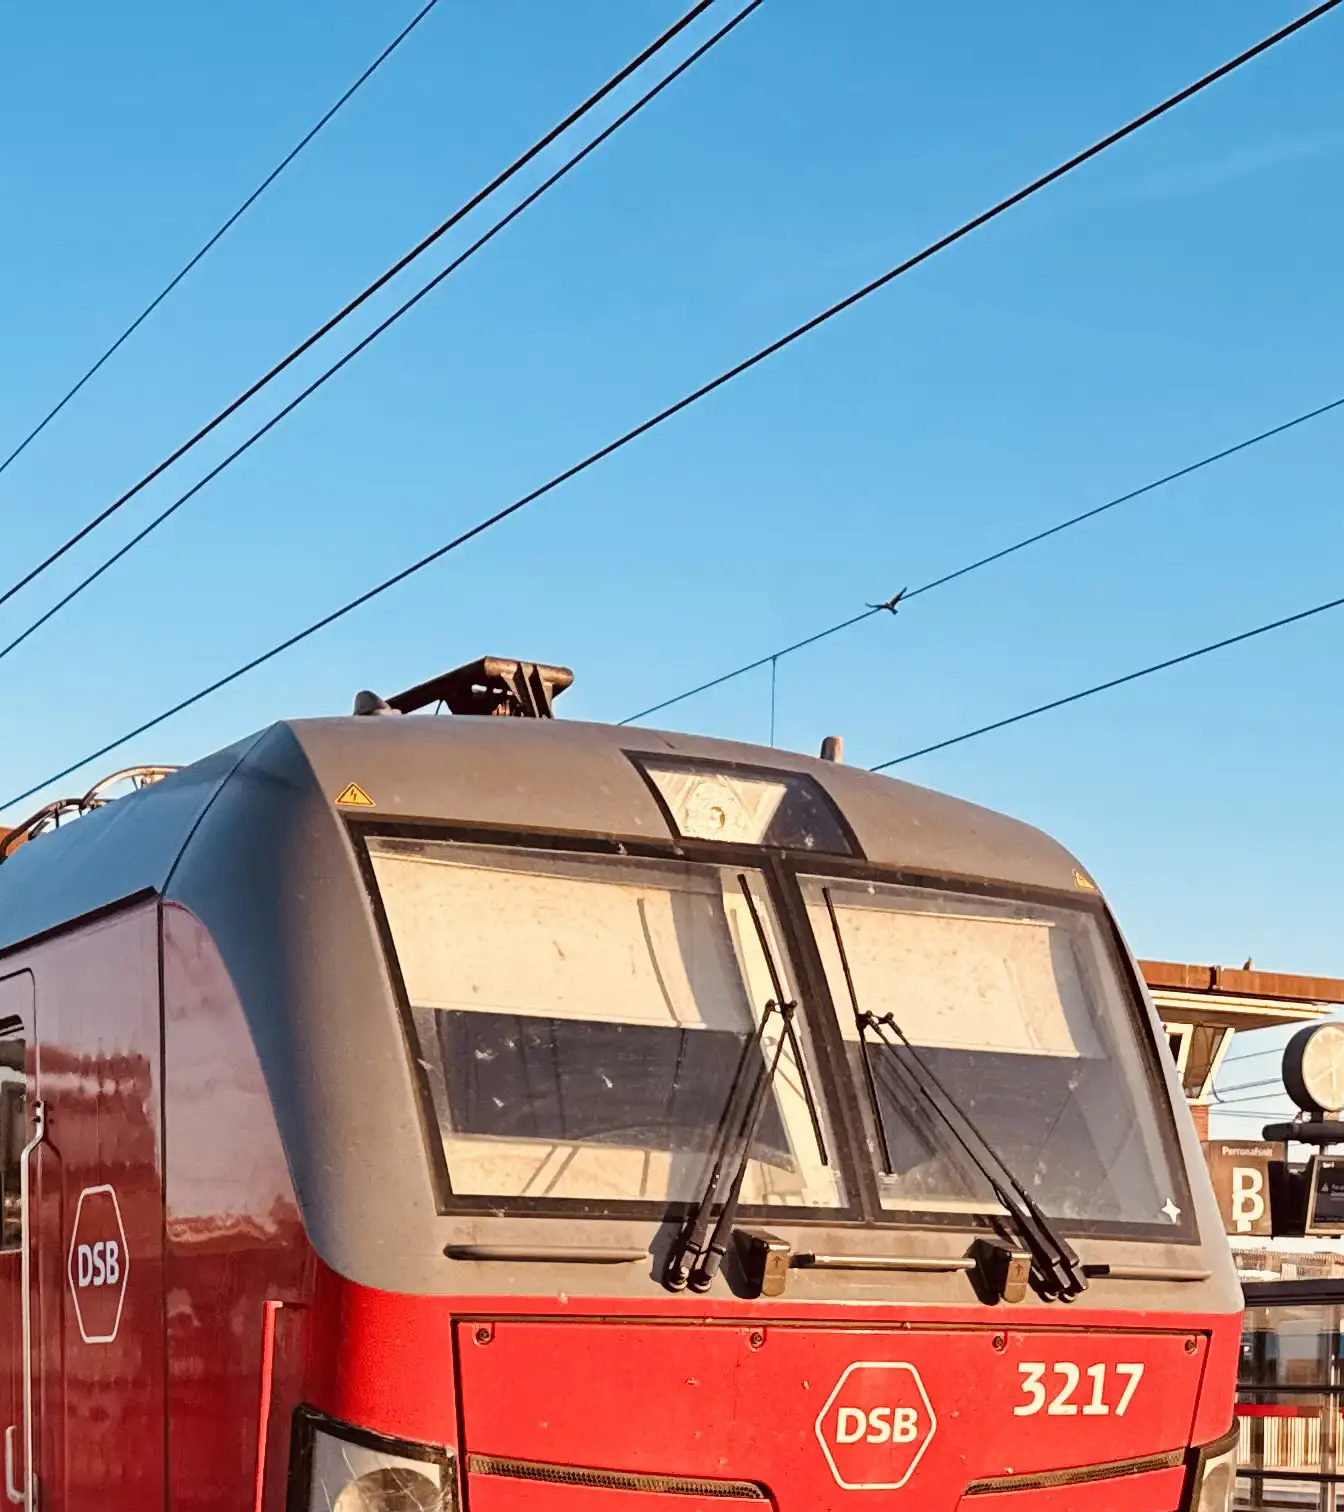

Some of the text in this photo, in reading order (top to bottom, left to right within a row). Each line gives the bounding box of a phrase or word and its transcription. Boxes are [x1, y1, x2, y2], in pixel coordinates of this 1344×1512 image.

[1232, 1167, 1265, 1221] B
[78, 1240, 120, 1287] DSB
[1013, 1362, 1145, 1417] 3217
[836, 1407, 918, 1444] DSB
